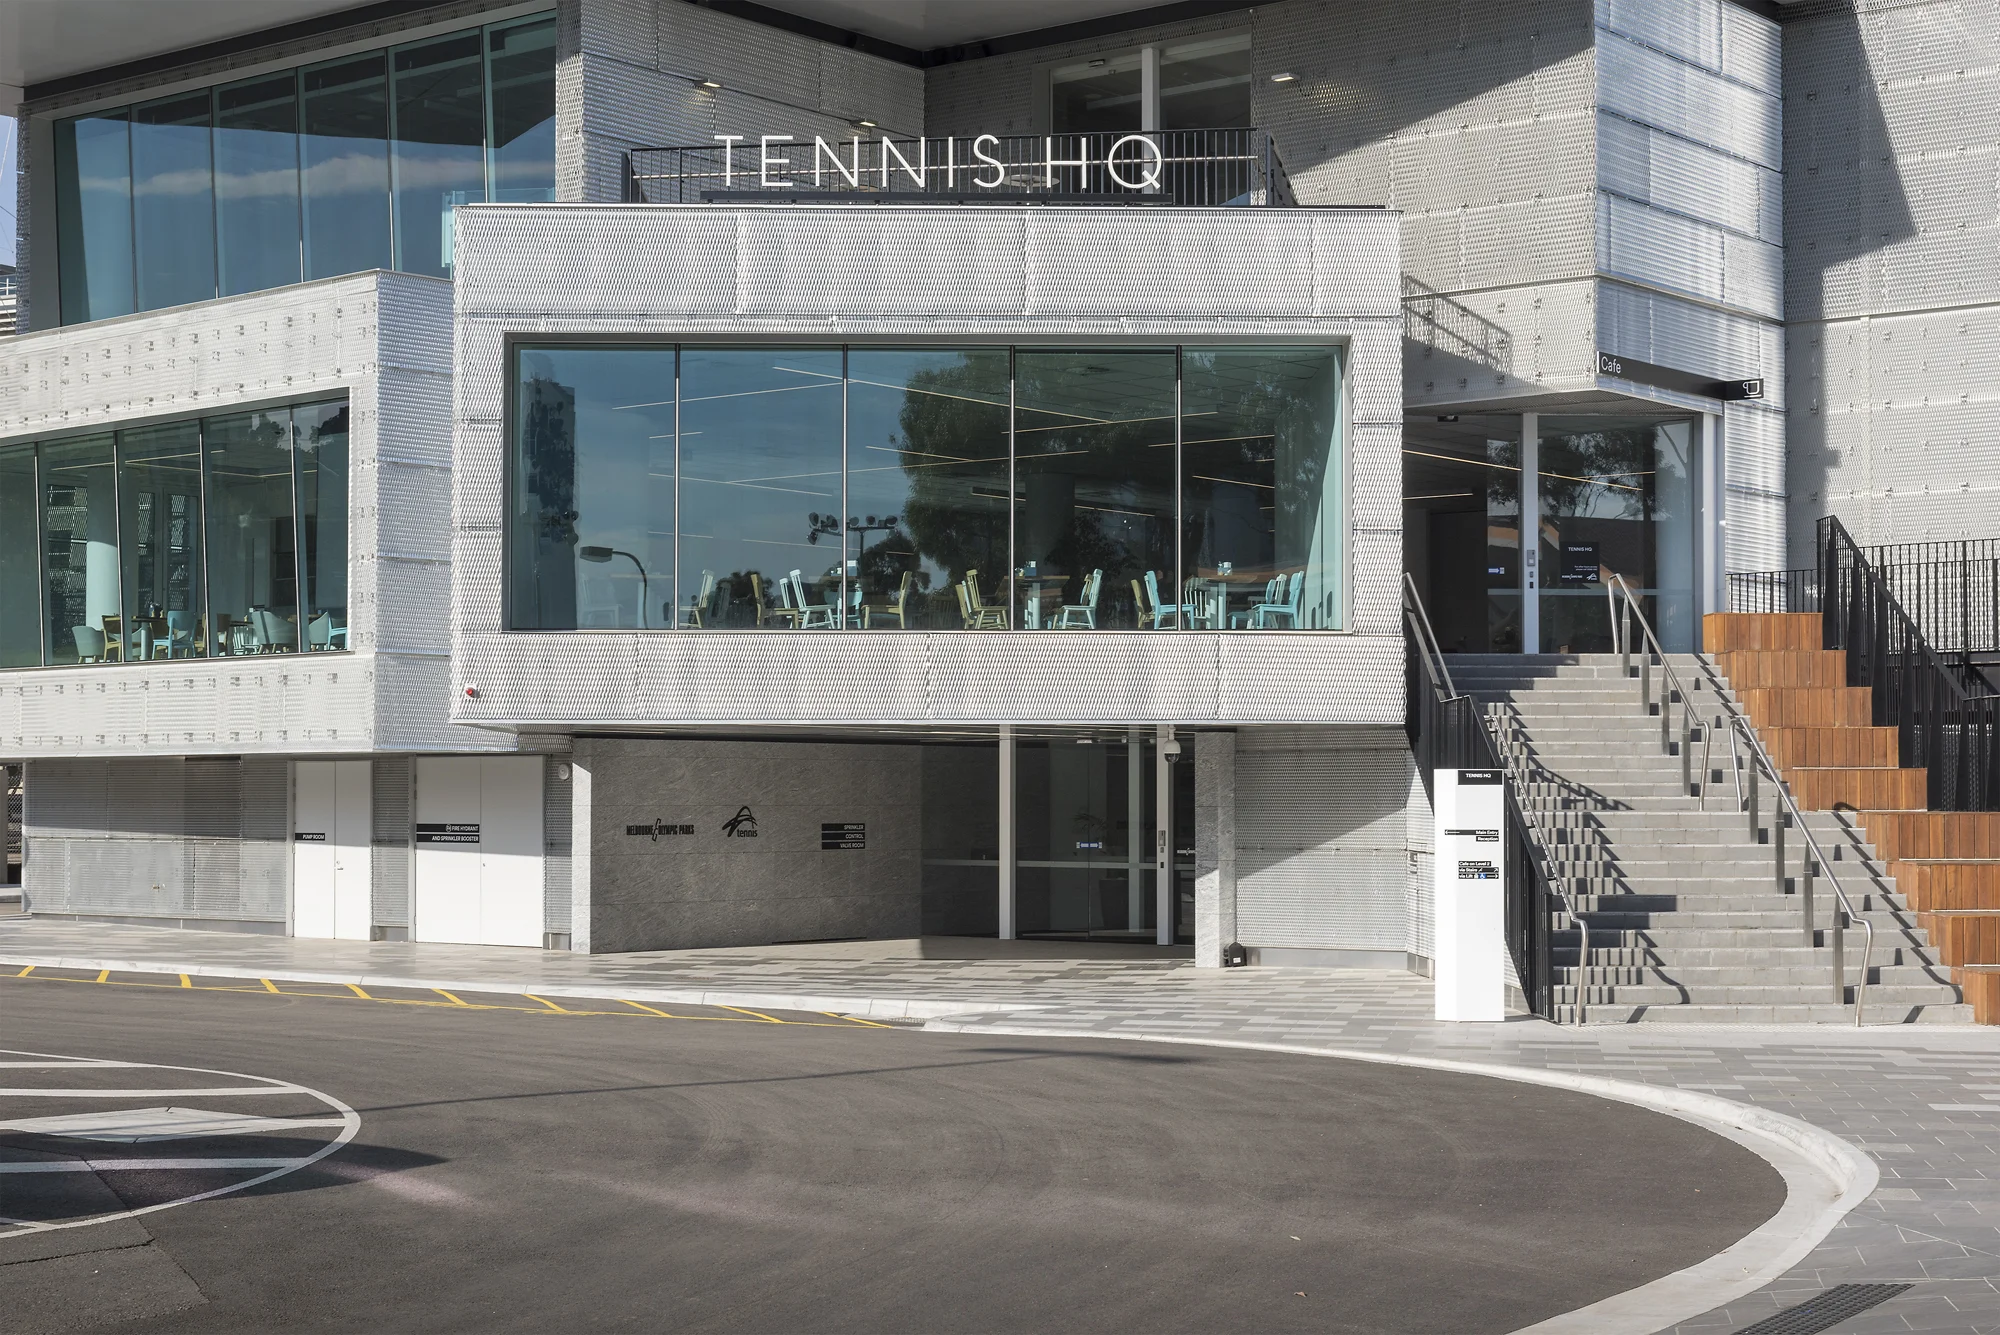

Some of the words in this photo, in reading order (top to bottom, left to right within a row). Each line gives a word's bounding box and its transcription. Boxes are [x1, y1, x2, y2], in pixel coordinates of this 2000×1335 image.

[714, 134, 1005, 188] TENNIS
[1046, 135, 1162, 190] HQ
[1600, 356, 1622, 374] Cafe
[626, 825, 654, 836] MELBOURNE
[658, 824, 678, 835] OLYMPIC
[678, 824, 695, 835] PARKS
[736, 828, 758, 838] tennis
